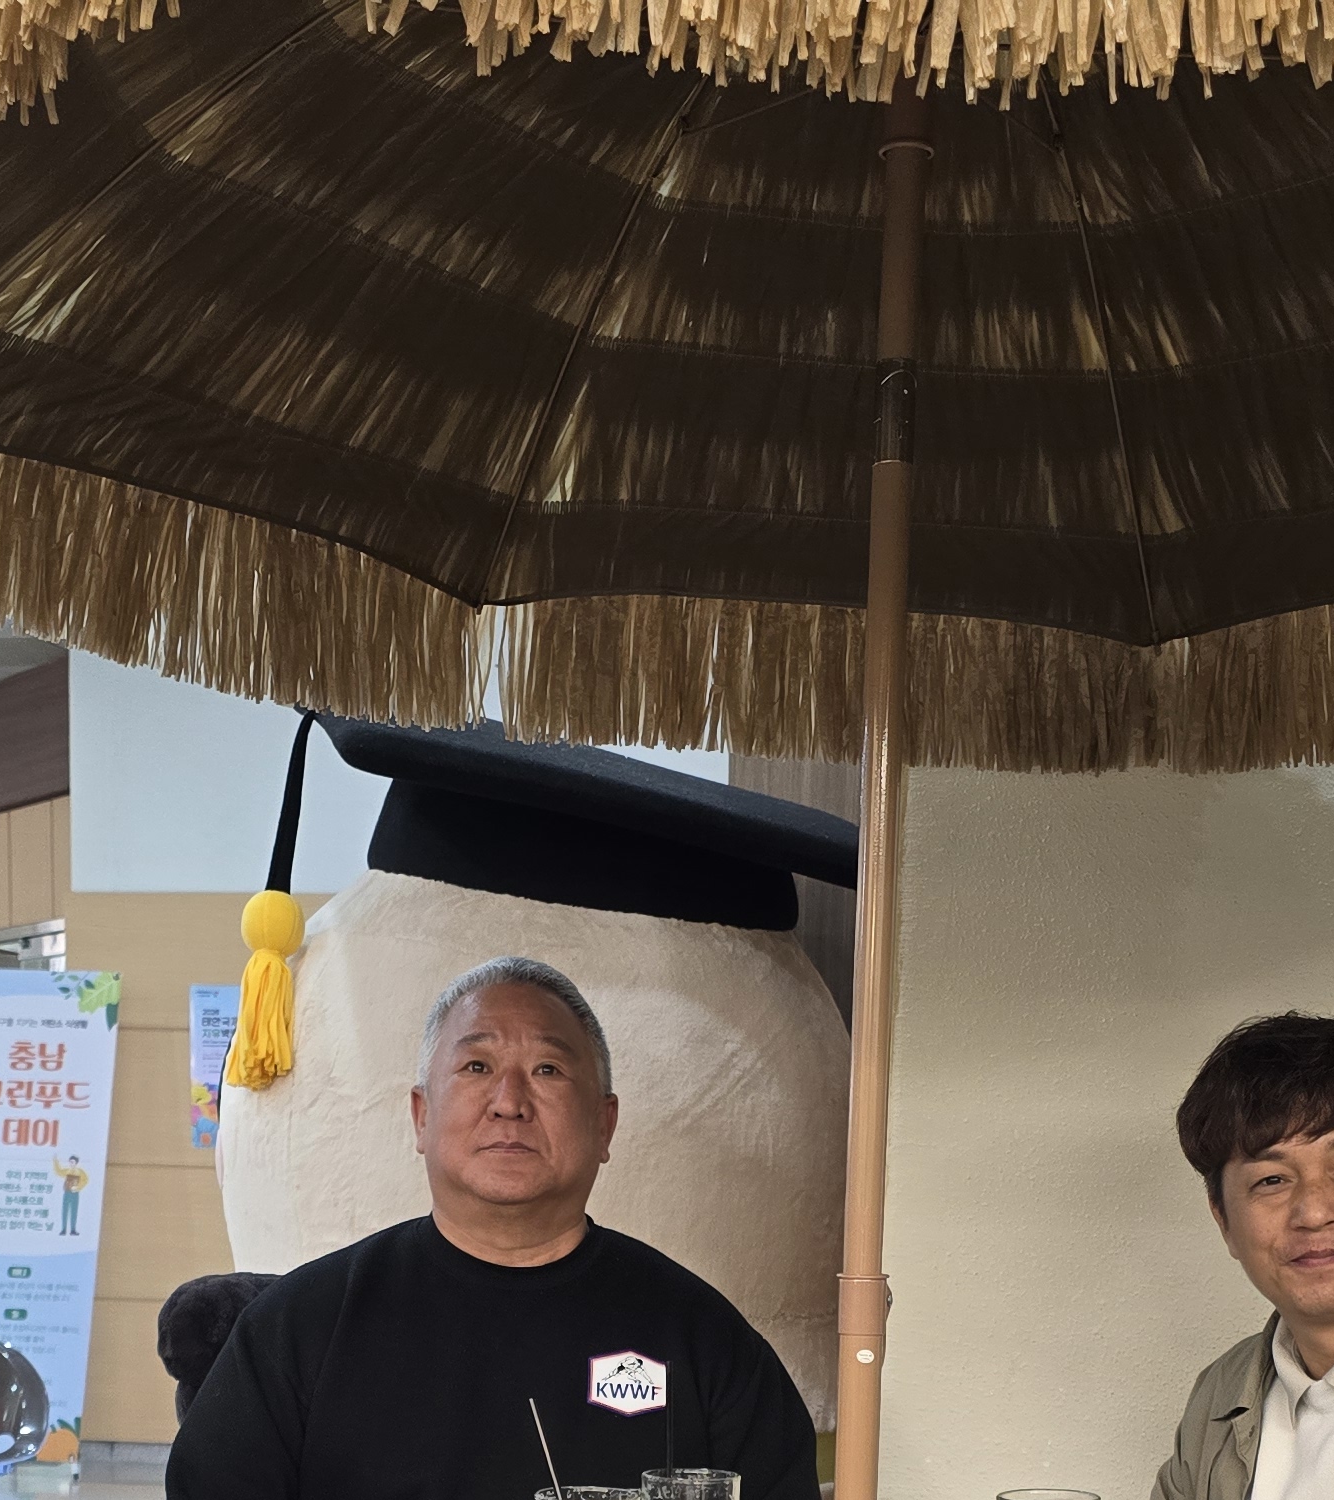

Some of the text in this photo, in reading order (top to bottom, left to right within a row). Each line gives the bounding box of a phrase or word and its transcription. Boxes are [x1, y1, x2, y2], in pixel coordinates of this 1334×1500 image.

[41, 1019, 63, 1029] 저탄소
[8, 1041, 67, 1072] 충남
[1, 1117, 60, 1147] 데이
[596, 1382, 662, 1401] KWWF
